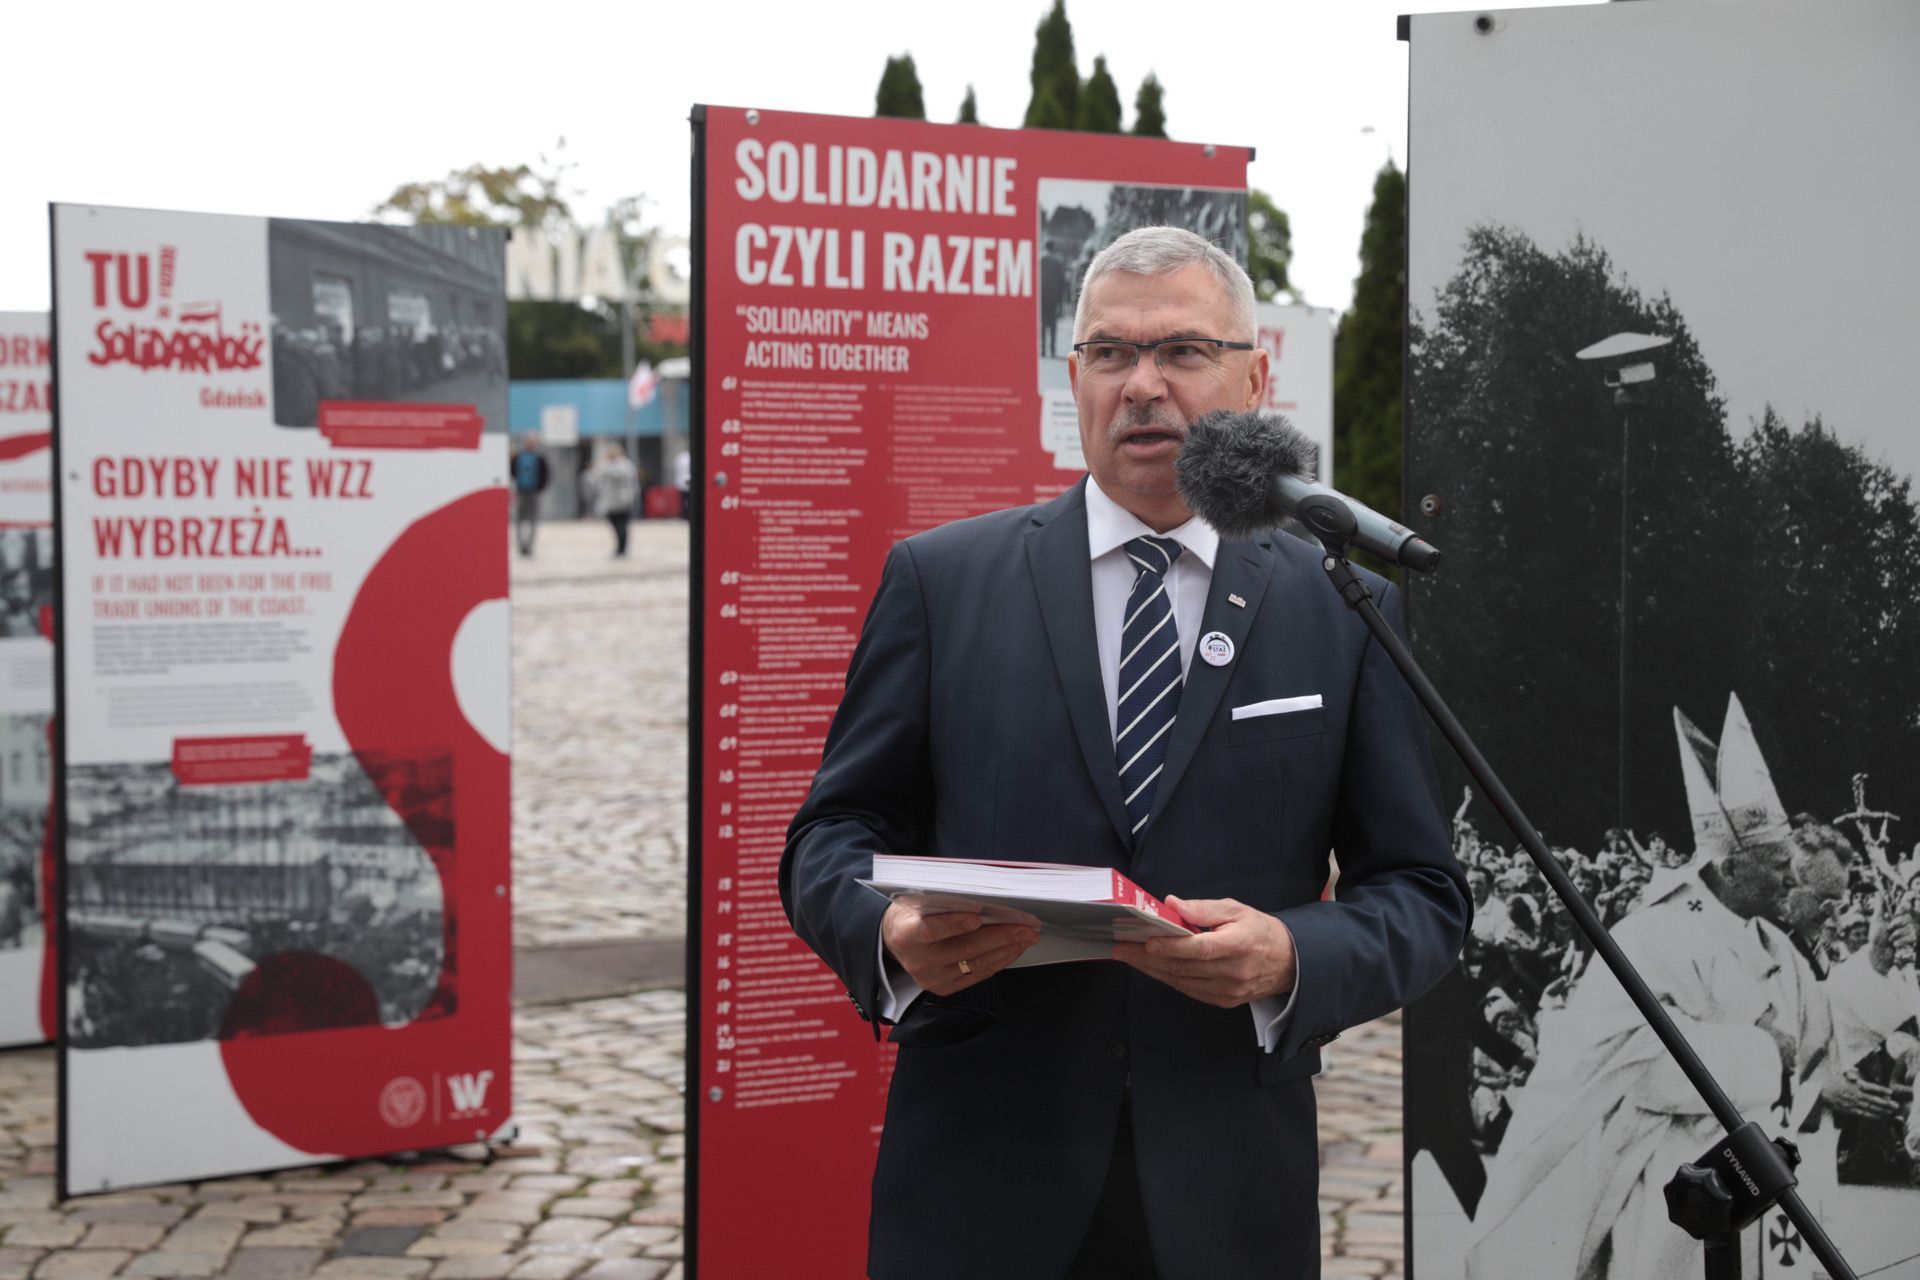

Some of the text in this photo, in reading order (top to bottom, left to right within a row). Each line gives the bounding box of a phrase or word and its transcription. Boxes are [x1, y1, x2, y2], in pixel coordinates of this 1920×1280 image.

[735, 138, 1017, 216] SOLIDARNIE
[735, 223, 1033, 298] CZYLI RAZEM
[867, 311, 929, 340] MEANS
[744, 340, 910, 373] ACTING TOGETHER
[92, 456, 219, 498] GDYBY
[235, 459, 292, 498] NIE
[306, 459, 375, 499] WZZ
[1723, 1148, 1760, 1197] DYNAWID
